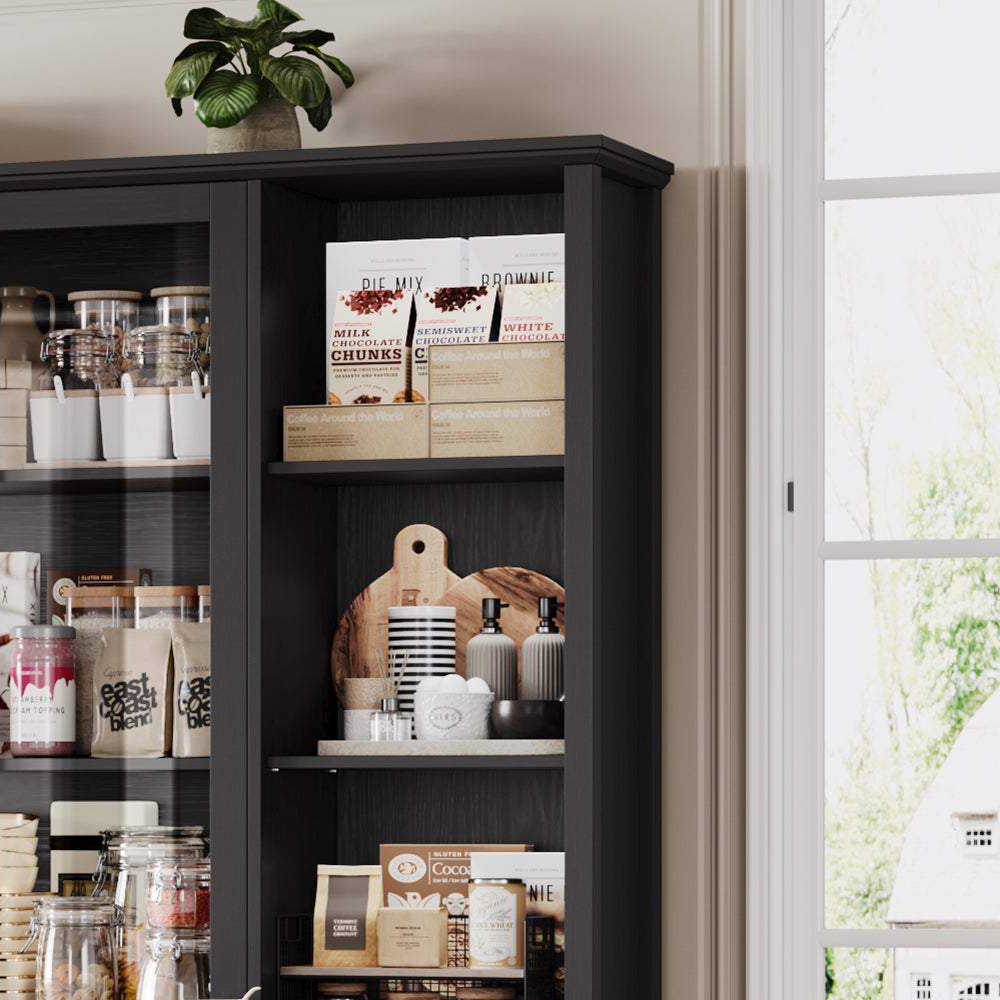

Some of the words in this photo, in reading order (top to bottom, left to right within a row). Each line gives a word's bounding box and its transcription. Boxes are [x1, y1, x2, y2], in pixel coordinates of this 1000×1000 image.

[362, 277, 386, 291] PIE
[395, 276, 424, 295] MIX
[481, 270, 555, 292] BROWNIE
[334, 329, 370, 338] MILK
[416, 326, 488, 335] SEMISWEET
[503, 322, 553, 332] WHITE
[332, 338, 403, 348] CHOCOLATE
[415, 335, 486, 345] CHOCOLATE
[331, 348, 402, 361] CHUNKS
[432, 349, 462, 361] Coffee
[465, 350, 500, 360] Around
[503, 350, 519, 359] the
[521, 348, 550, 358] World
[287, 414, 319, 424] Coffee
[321, 413, 355, 422] Around
[357, 413, 374, 422] the
[375, 411, 404, 421] World
[432, 408, 464, 420] Coffee
[465, 408, 500, 418] Around
[503, 408, 520, 417] the
[521, 407, 550, 417] World
[101, 672, 149, 702] east
[100, 687, 157, 718] coast
[110, 709, 152, 732] blend
